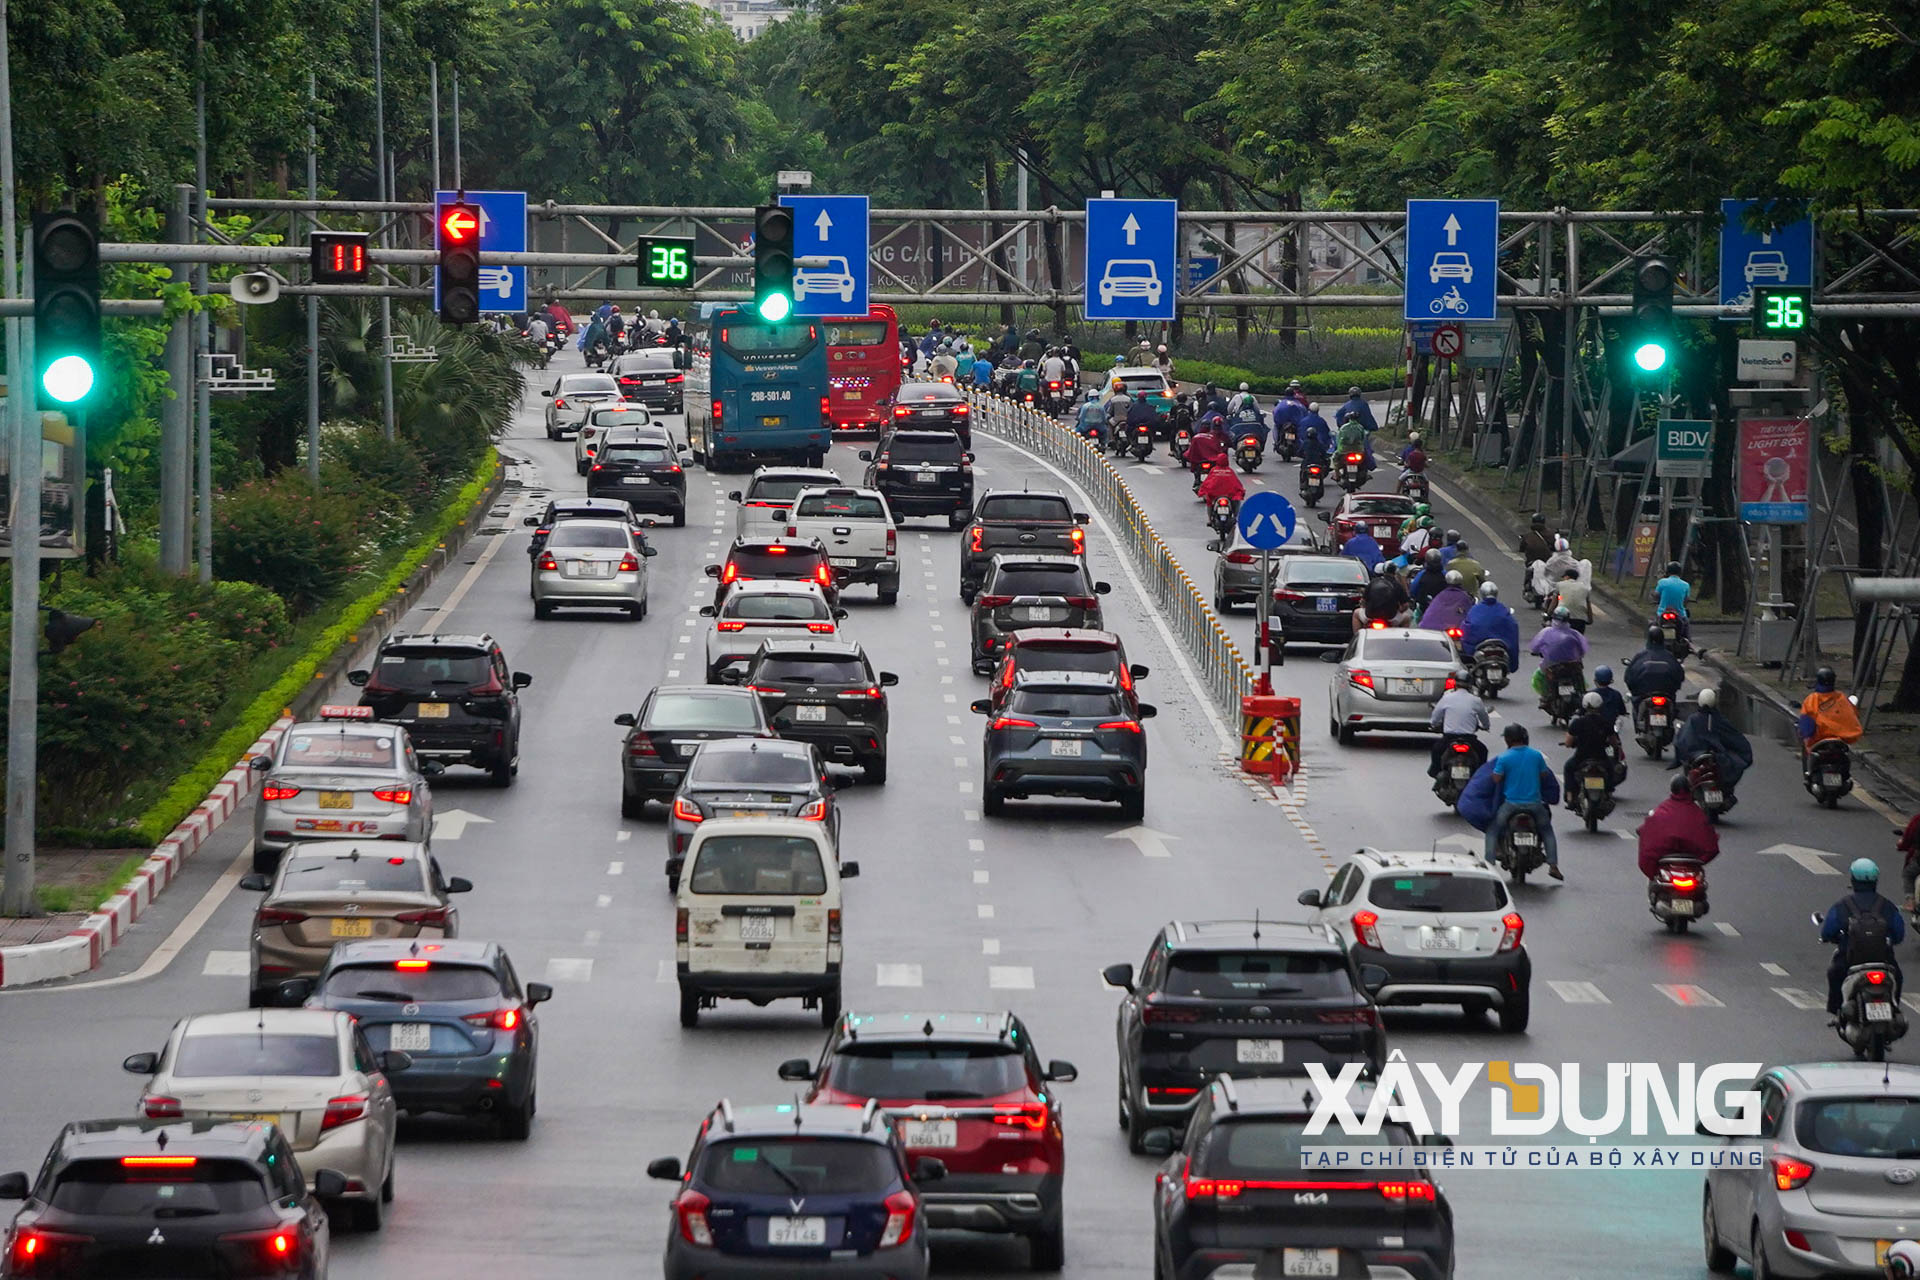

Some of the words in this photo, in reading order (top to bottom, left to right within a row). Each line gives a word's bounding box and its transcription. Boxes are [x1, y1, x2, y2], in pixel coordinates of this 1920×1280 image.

[334, 244, 364, 272] 11
[652, 247, 688, 279] 36
[1766, 296, 1804, 328] 36
[751, 391, 791, 402] 29B-501.40
[1668, 431, 1710, 446] BIDV
[1747, 439, 1780, 449] LIGHT
[1780, 437, 1803, 447] BOX
